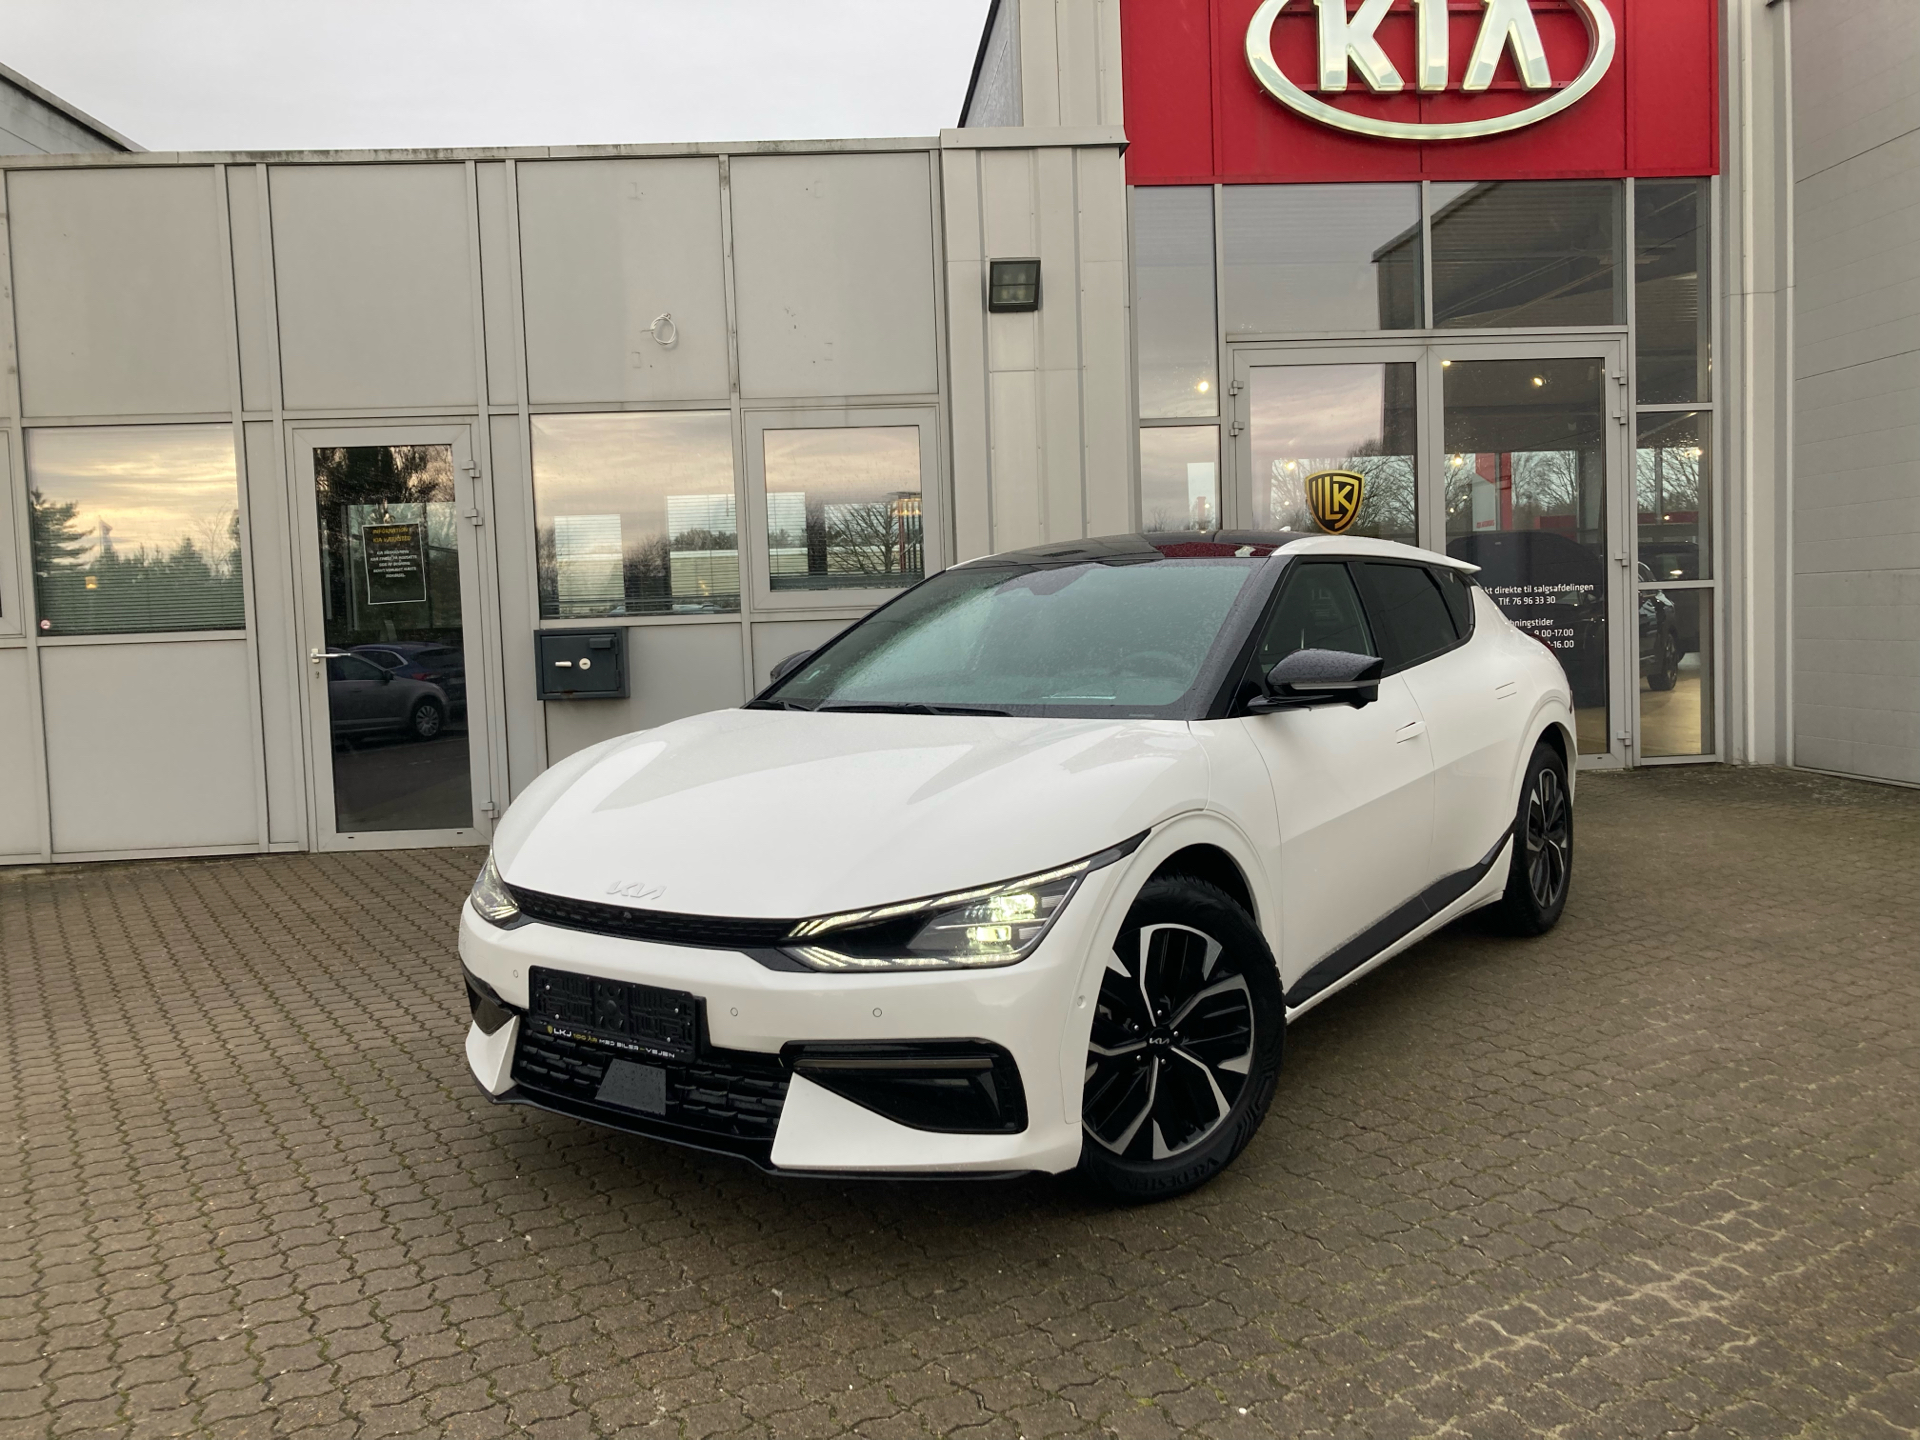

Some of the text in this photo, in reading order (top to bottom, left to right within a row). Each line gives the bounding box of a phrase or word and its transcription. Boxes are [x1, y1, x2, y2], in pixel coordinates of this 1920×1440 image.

[1314, 0, 1552, 93] KIA
[1494, 585, 1522, 594] direkte
[1523, 585, 1532, 593] til
[1533, 583, 1594, 596] salgsafdelingen
[1498, 595, 1556, 605] Tlf. 76 96 33 30
[553, 1027, 572, 1037] LKJ
[573, 1033, 586, 1041] 100
[599, 1038, 615, 1046] MED
[616, 1041, 639, 1051] BILER
[645, 1047, 675, 1059] VEJEN
